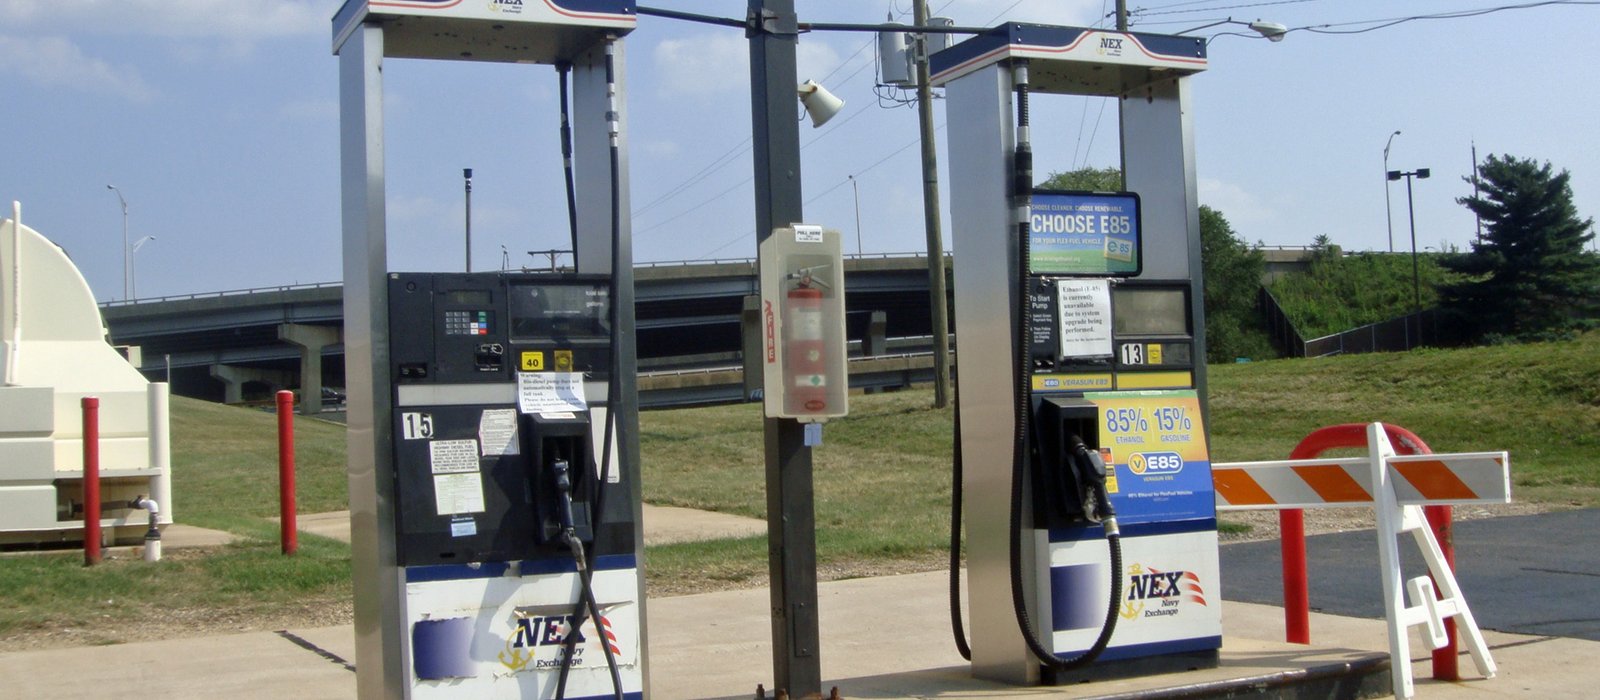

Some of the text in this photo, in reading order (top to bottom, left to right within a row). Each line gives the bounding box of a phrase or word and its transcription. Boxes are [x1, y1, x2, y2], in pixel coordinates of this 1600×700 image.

[1100, 38, 1123, 49] NEX
[1032, 214, 1130, 234] CHOOSE E85
[1124, 344, 1141, 364] 13
[526, 359, 539, 367] 40
[407, 414, 430, 438] 15
[1106, 407, 1191, 433] 85% 15%
[1148, 456, 1180, 469] E85
[1128, 571, 1183, 600] NEX
[1144, 608, 1178, 618] Exchange
[513, 616, 589, 648] NEX
[560, 648, 584, 657] Nvy
[536, 658, 583, 668] Exchge
